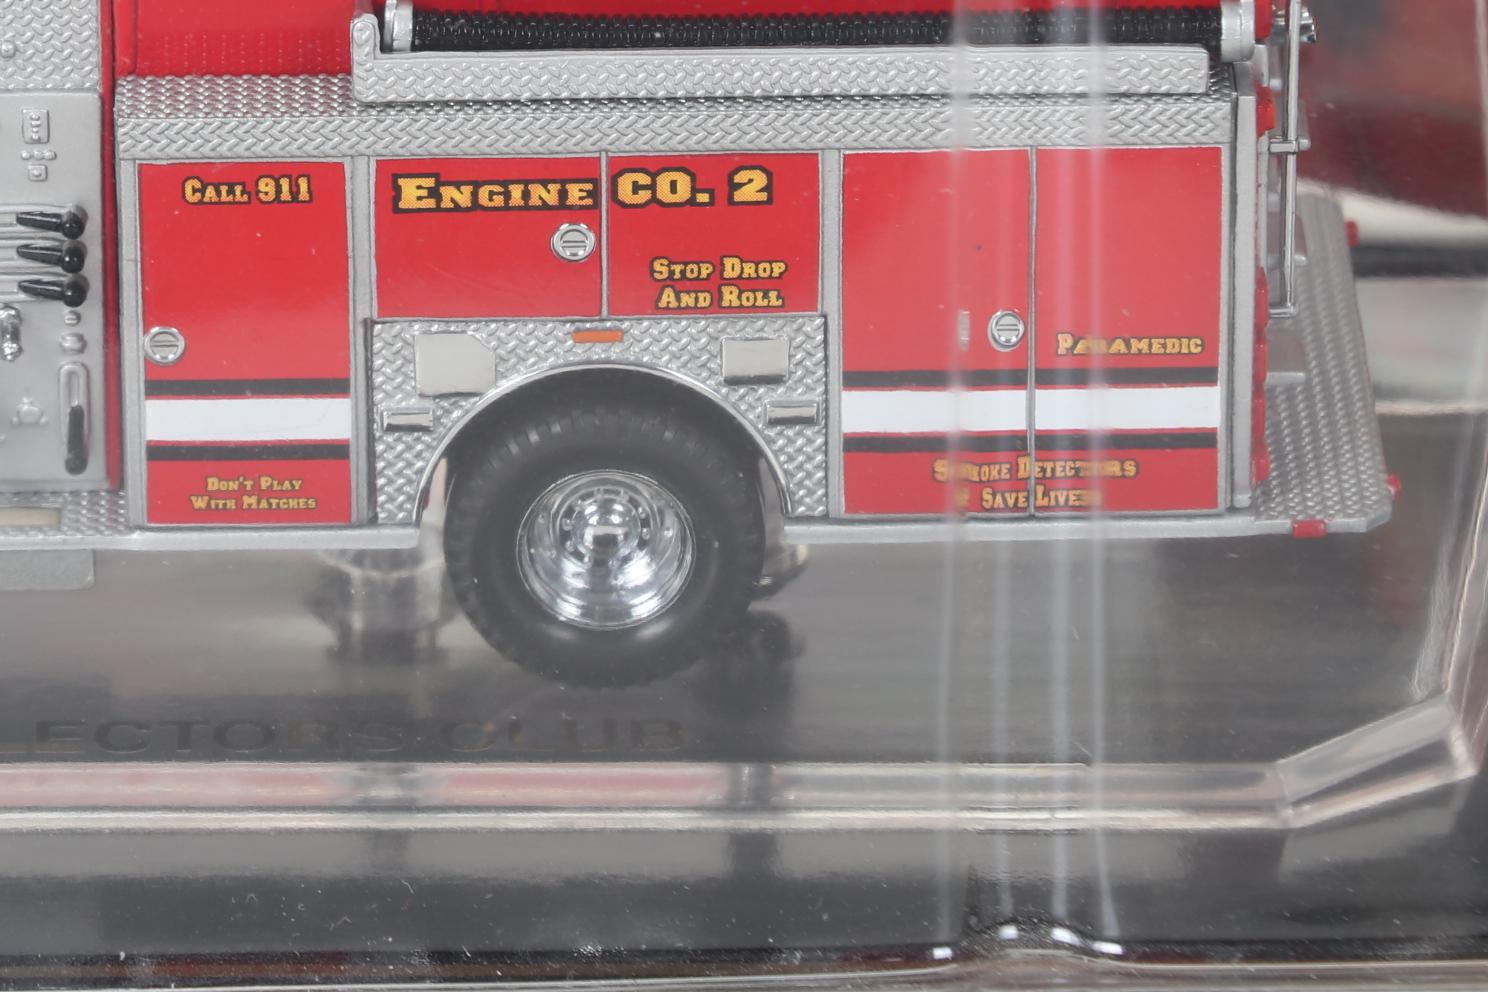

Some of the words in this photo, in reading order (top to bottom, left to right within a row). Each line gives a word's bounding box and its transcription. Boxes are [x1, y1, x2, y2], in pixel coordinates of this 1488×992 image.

[182, 175, 250, 205] CALL
[255, 175, 311, 203] 911
[392, 173, 598, 213] ENGINE
[611, 167, 715, 208] CO.
[726, 166, 774, 207] 2
[650, 257, 715, 283] STOP
[721, 255, 788, 282] DROP
[656, 286, 713, 311] AND
[719, 284, 785, 309] ROLL
[206, 475, 255, 492] DON'T
[259, 475, 303, 492] PLAY
[189, 494, 238, 510] WITH
[241, 494, 317, 510] MATCHES
[981, 488, 1029, 509] SAVE
[440, 716, 686, 754] CLUB
